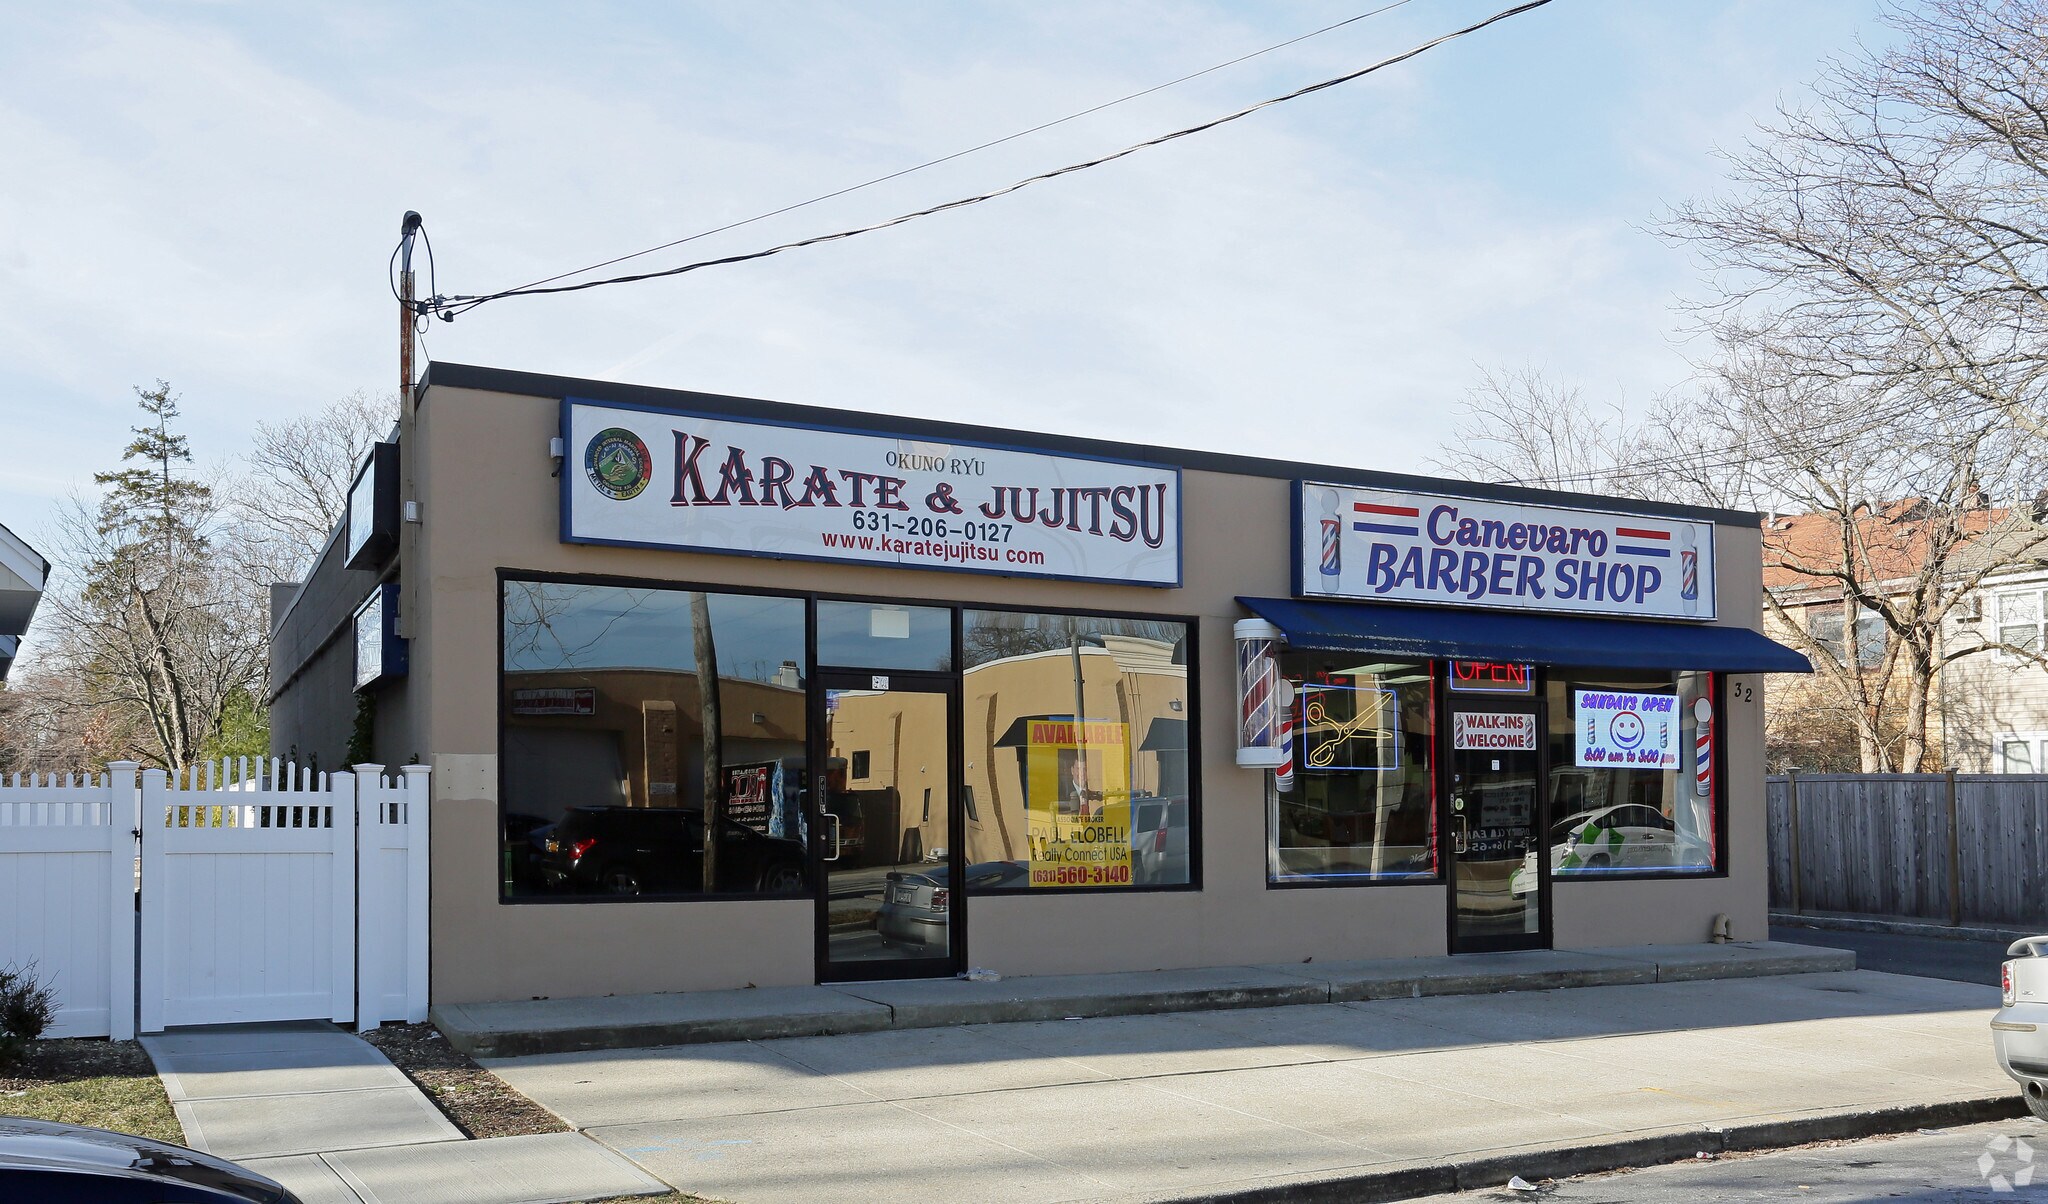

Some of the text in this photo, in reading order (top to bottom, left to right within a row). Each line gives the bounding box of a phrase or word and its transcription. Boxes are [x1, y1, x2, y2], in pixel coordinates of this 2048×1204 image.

[885, 450, 986, 476] OKUNO RYU
[590, 473, 606, 491] METAL
[621, 485, 641, 498] EARTH
[669, 429, 1167, 549] KARATE & JUJITSU
[852, 510, 1013, 543] 631-206-0127
[1426, 504, 1608, 557] Canevaro
[1366, 542, 1662, 604] BARBER SHOP
[1455, 661, 1524, 685] OPEN
[1581, 693, 1674, 713] SUNDAYS OPEN
[1465, 715, 1524, 729] WALK-INS
[1032, 723, 1124, 744] AVAILABLE
[1466, 734, 1524, 747] WELCOME
[1608, 751, 1624, 763] am
[1626, 750, 1636, 762] to
[1638, 749, 1659, 764] 3:00
[1032, 826, 1128, 845] PAUL LLOBELL
[1032, 847, 1128, 864] Realty Connect USA
[1057, 865, 1129, 884] 560-3140
